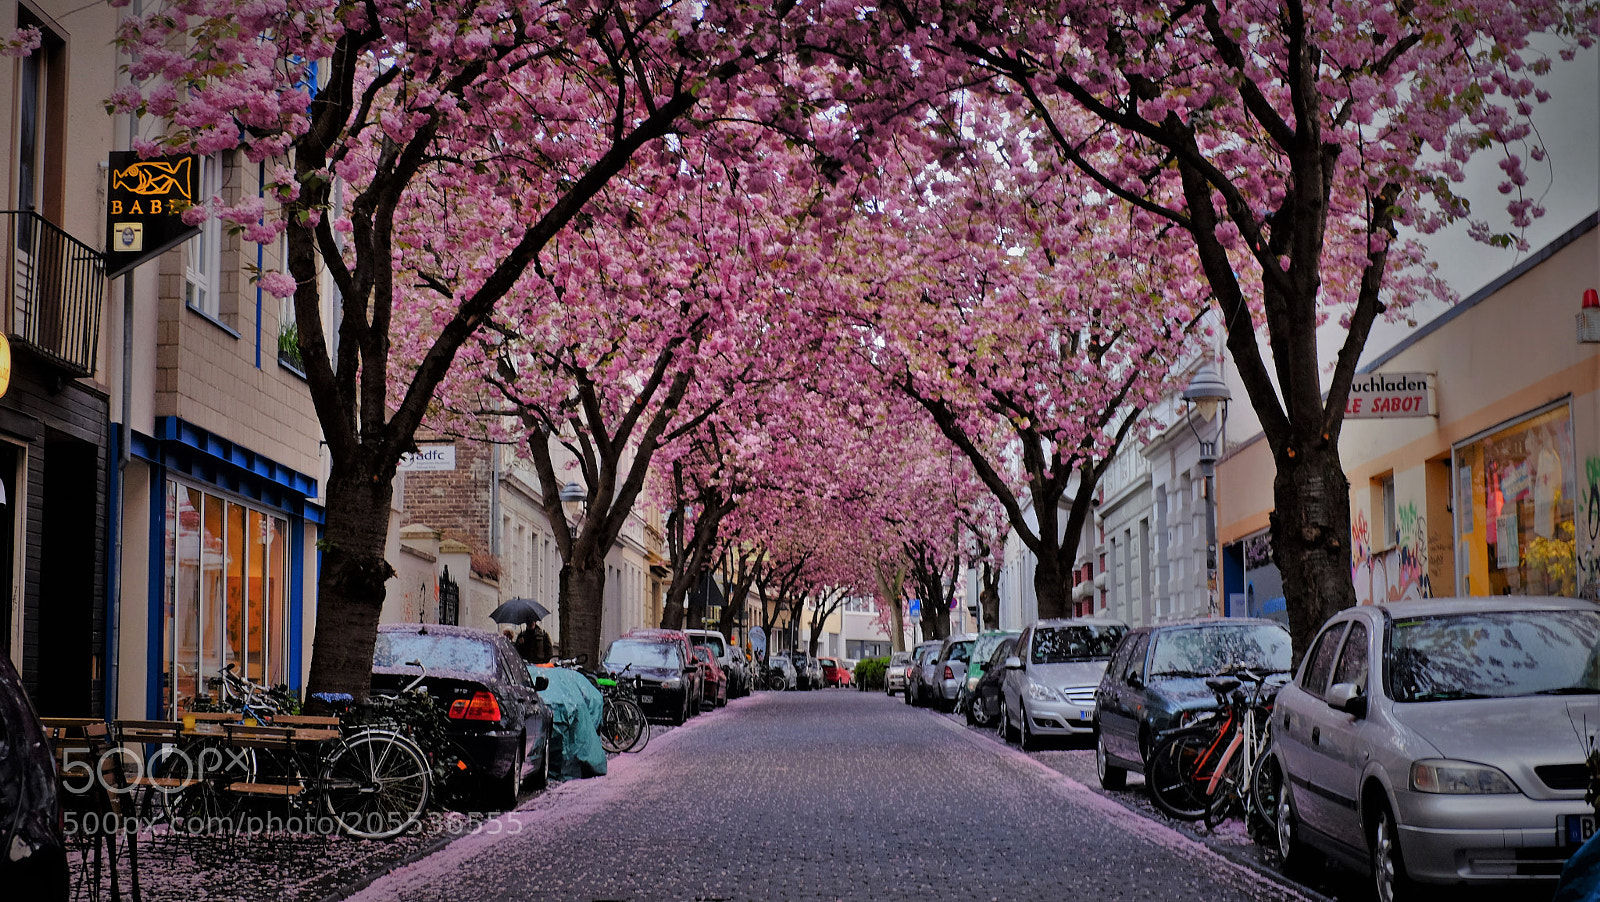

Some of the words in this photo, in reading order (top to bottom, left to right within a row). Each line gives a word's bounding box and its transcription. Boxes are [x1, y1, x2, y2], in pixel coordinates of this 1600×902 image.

[110, 199, 192, 215] BABE
[1351, 376, 1427, 392] uchladen
[1345, 398, 1363, 413] LE
[1371, 396, 1423, 412] SABOT
